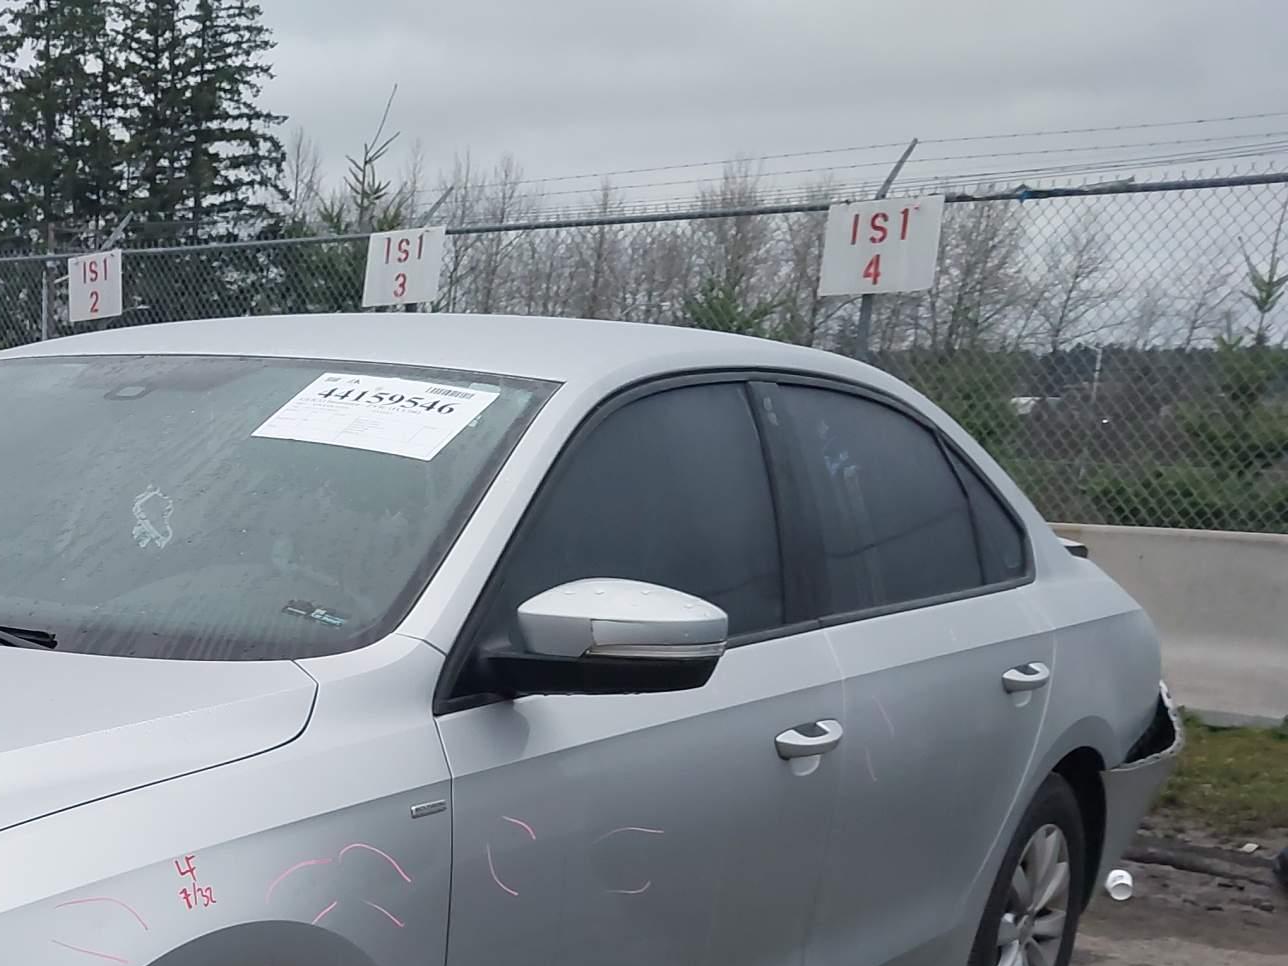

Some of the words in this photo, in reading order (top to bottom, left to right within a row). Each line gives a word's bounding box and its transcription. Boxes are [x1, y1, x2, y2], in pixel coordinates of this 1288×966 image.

[862, 253, 881, 286] 4
[393, 273, 407, 298] 3
[90, 291, 99, 313] 2
[317, 387, 460, 415] 44159546
